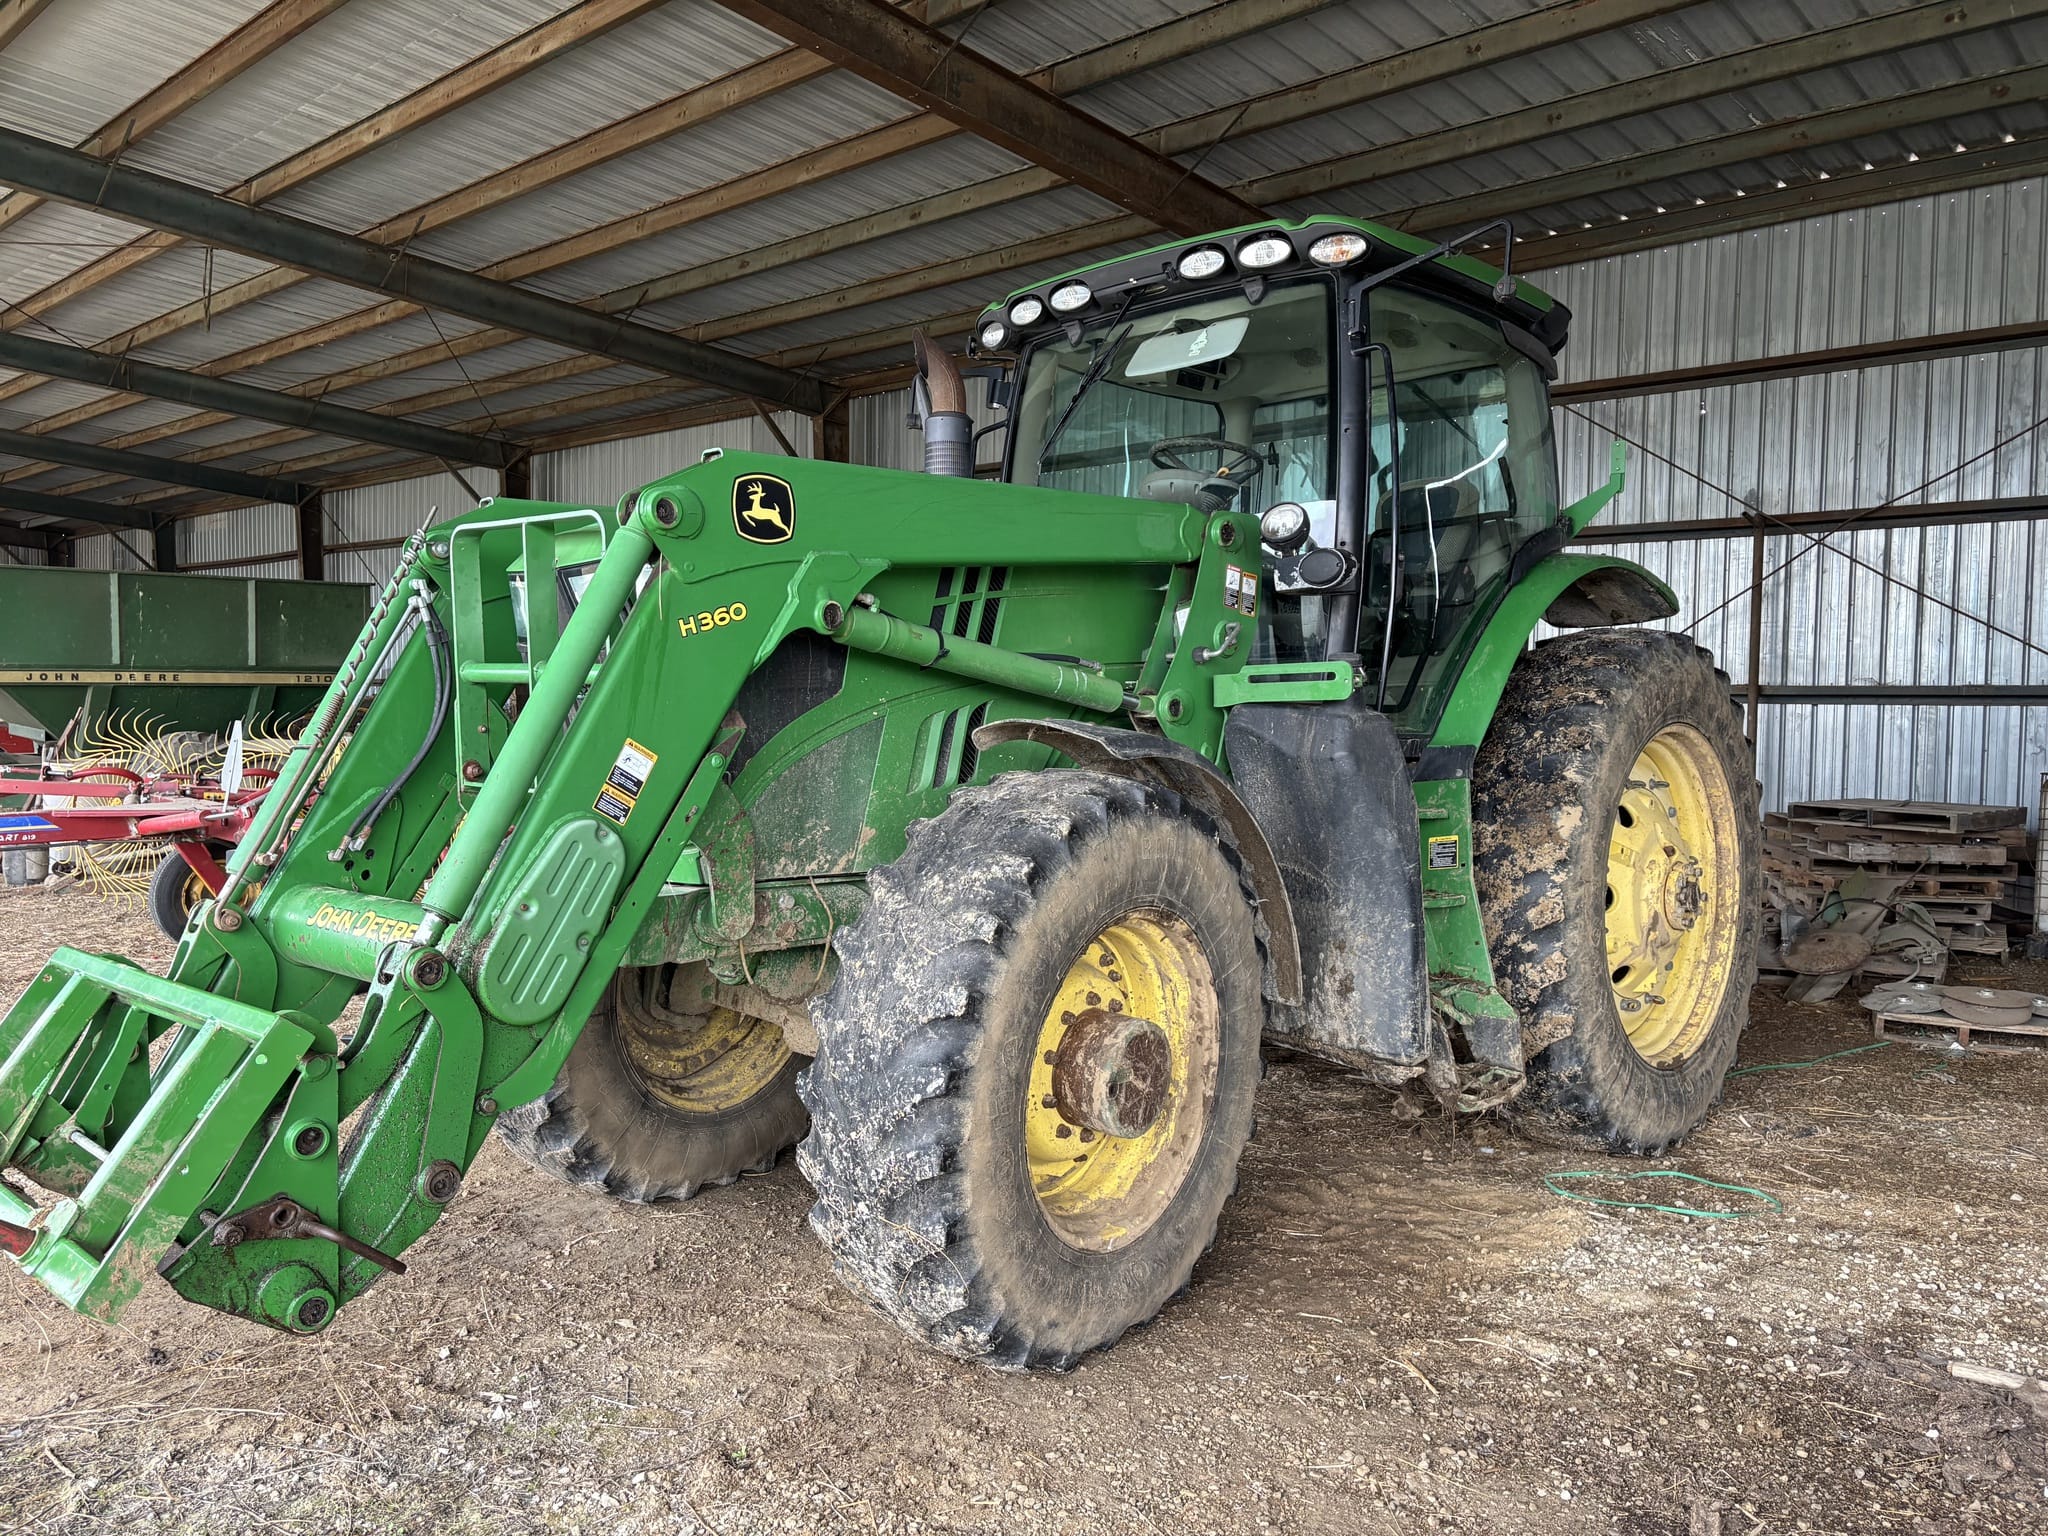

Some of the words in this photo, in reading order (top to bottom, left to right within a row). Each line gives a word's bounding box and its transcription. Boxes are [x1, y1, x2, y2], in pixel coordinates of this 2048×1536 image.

[677, 601, 748, 638] H360
[25, 672, 80, 681] JOHN
[114, 673, 180, 682] DEERE
[296, 675, 333, 683] 1210
[306, 902, 360, 934] JOHN
[353, 908, 420, 941] DEERE
